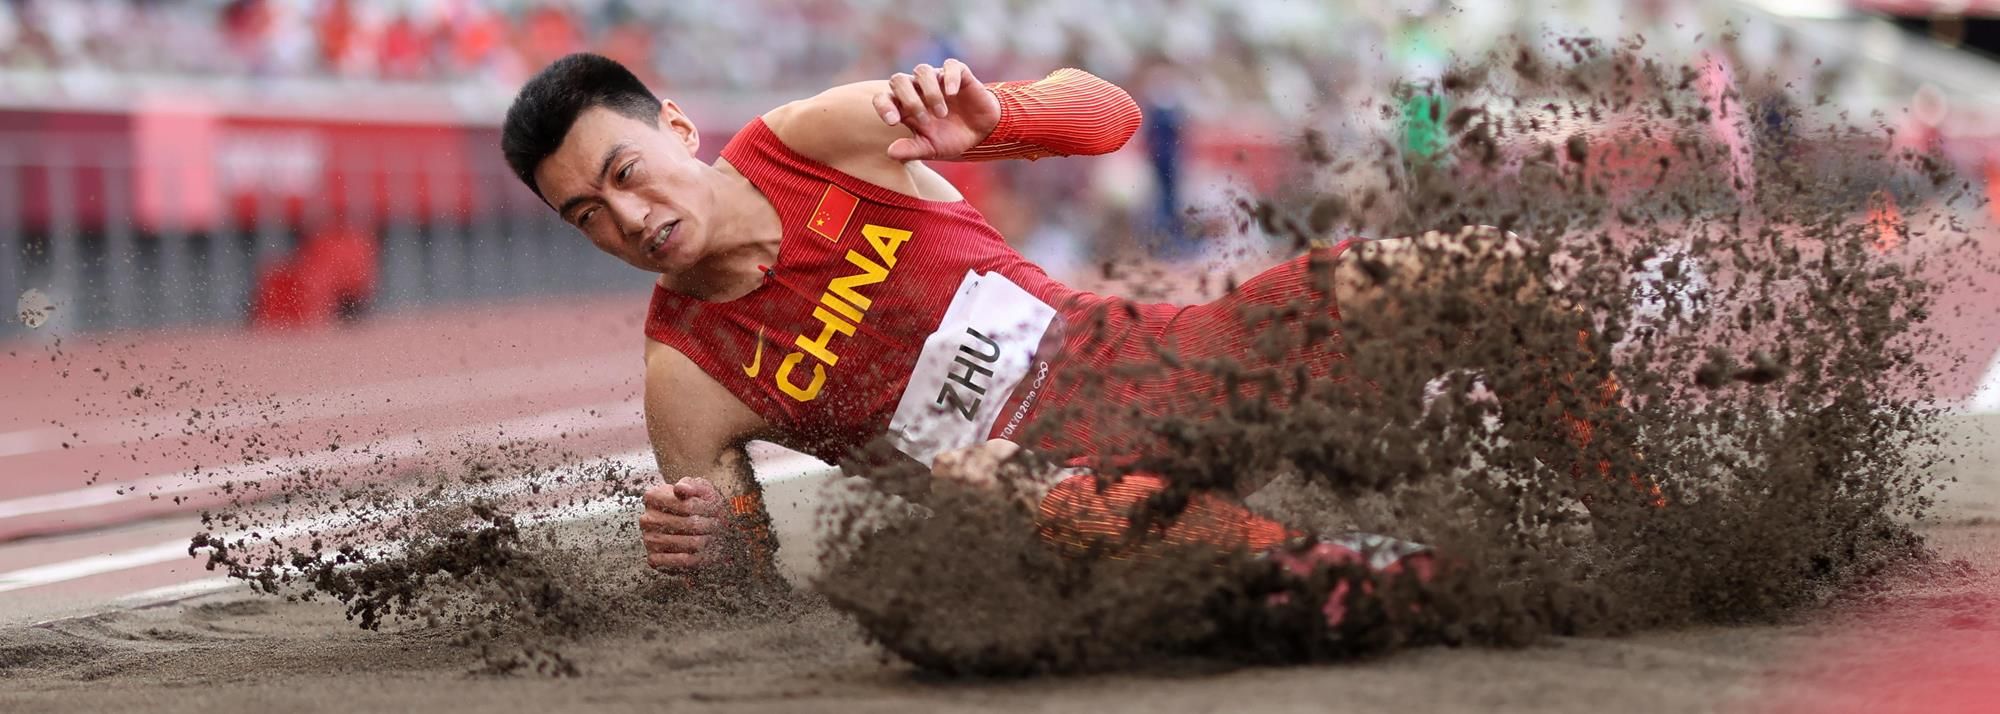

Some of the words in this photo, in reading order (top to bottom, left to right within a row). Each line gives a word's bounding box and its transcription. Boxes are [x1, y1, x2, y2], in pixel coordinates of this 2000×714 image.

[775, 223, 913, 402] CHINA
[936, 326, 1001, 423] ZHU
[1000, 411, 1024, 440] TOKYO
